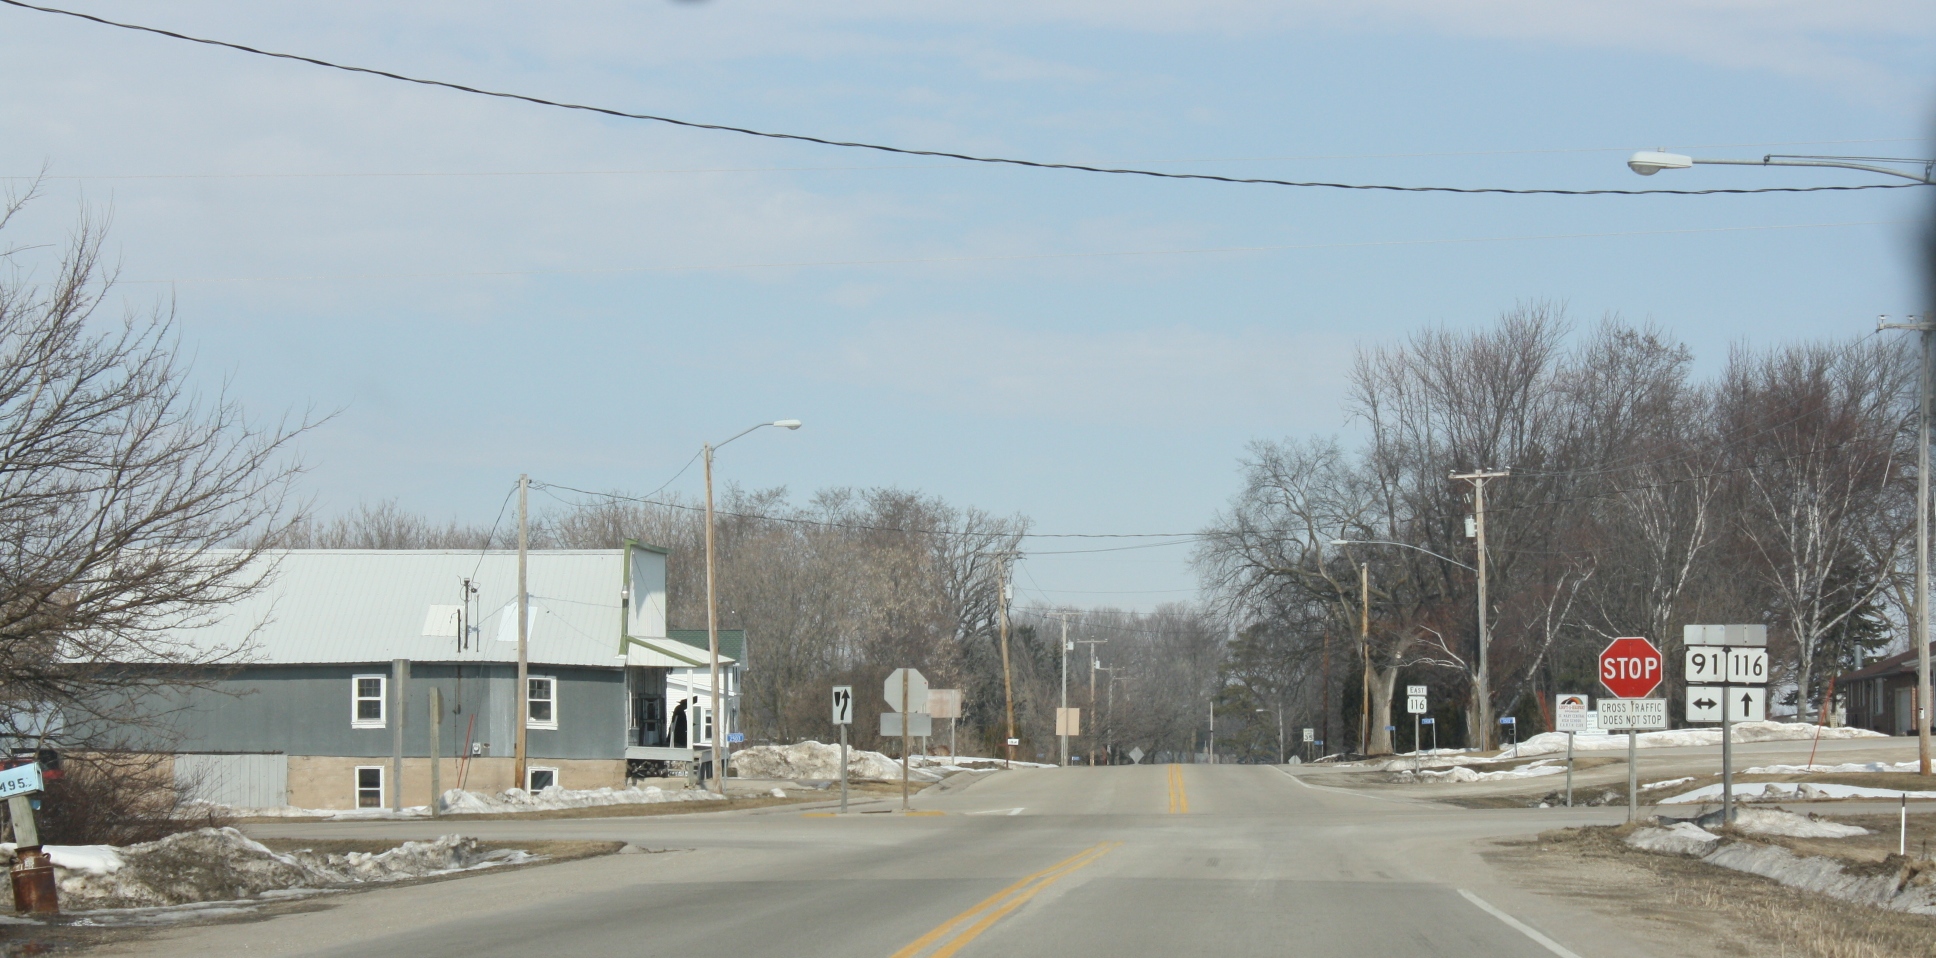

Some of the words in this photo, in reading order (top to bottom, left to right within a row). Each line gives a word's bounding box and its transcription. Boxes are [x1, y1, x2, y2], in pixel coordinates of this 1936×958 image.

[1604, 658, 1657, 679] STOP
[1691, 653, 1718, 675] 91
[1734, 654, 1763, 676] 116
[1411, 699, 1424, 710] 116
[1601, 703, 1627, 713] CROSS
[1631, 702, 1662, 713] TRAFFIC
[1603, 715, 1623, 725] DOES
[1626, 715, 1641, 725] NOT
[1642, 715, 1662, 725] STOP
